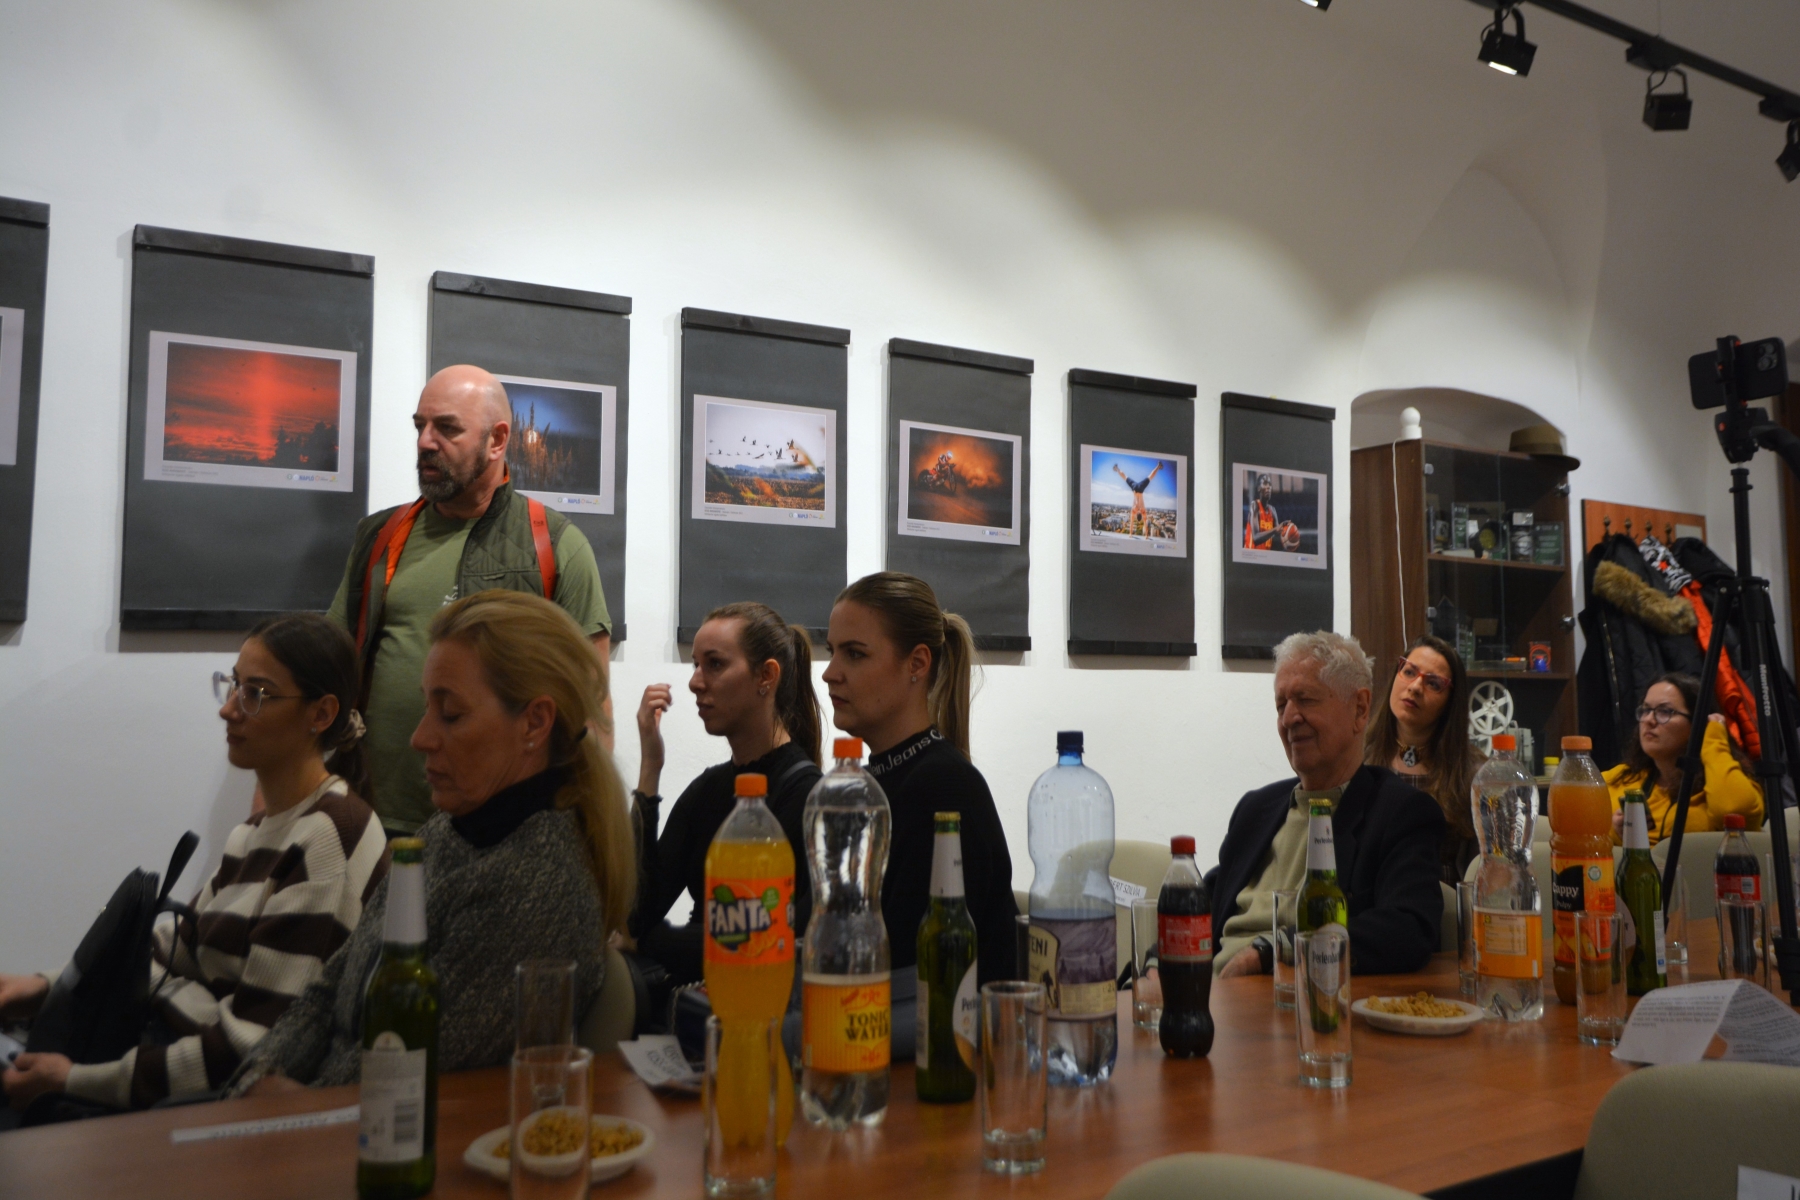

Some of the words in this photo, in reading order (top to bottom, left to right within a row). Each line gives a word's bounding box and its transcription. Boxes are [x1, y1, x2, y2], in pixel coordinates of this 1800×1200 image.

[1759, 664, 1771, 716] Manfrotto
[886, 736, 931, 771] Jeans
[1122, 884, 1141, 897] SZILVA
[1552, 881, 1580, 898] Cappy
[707, 898, 771, 934] FANTA
[846, 1008, 890, 1028] TONIC
